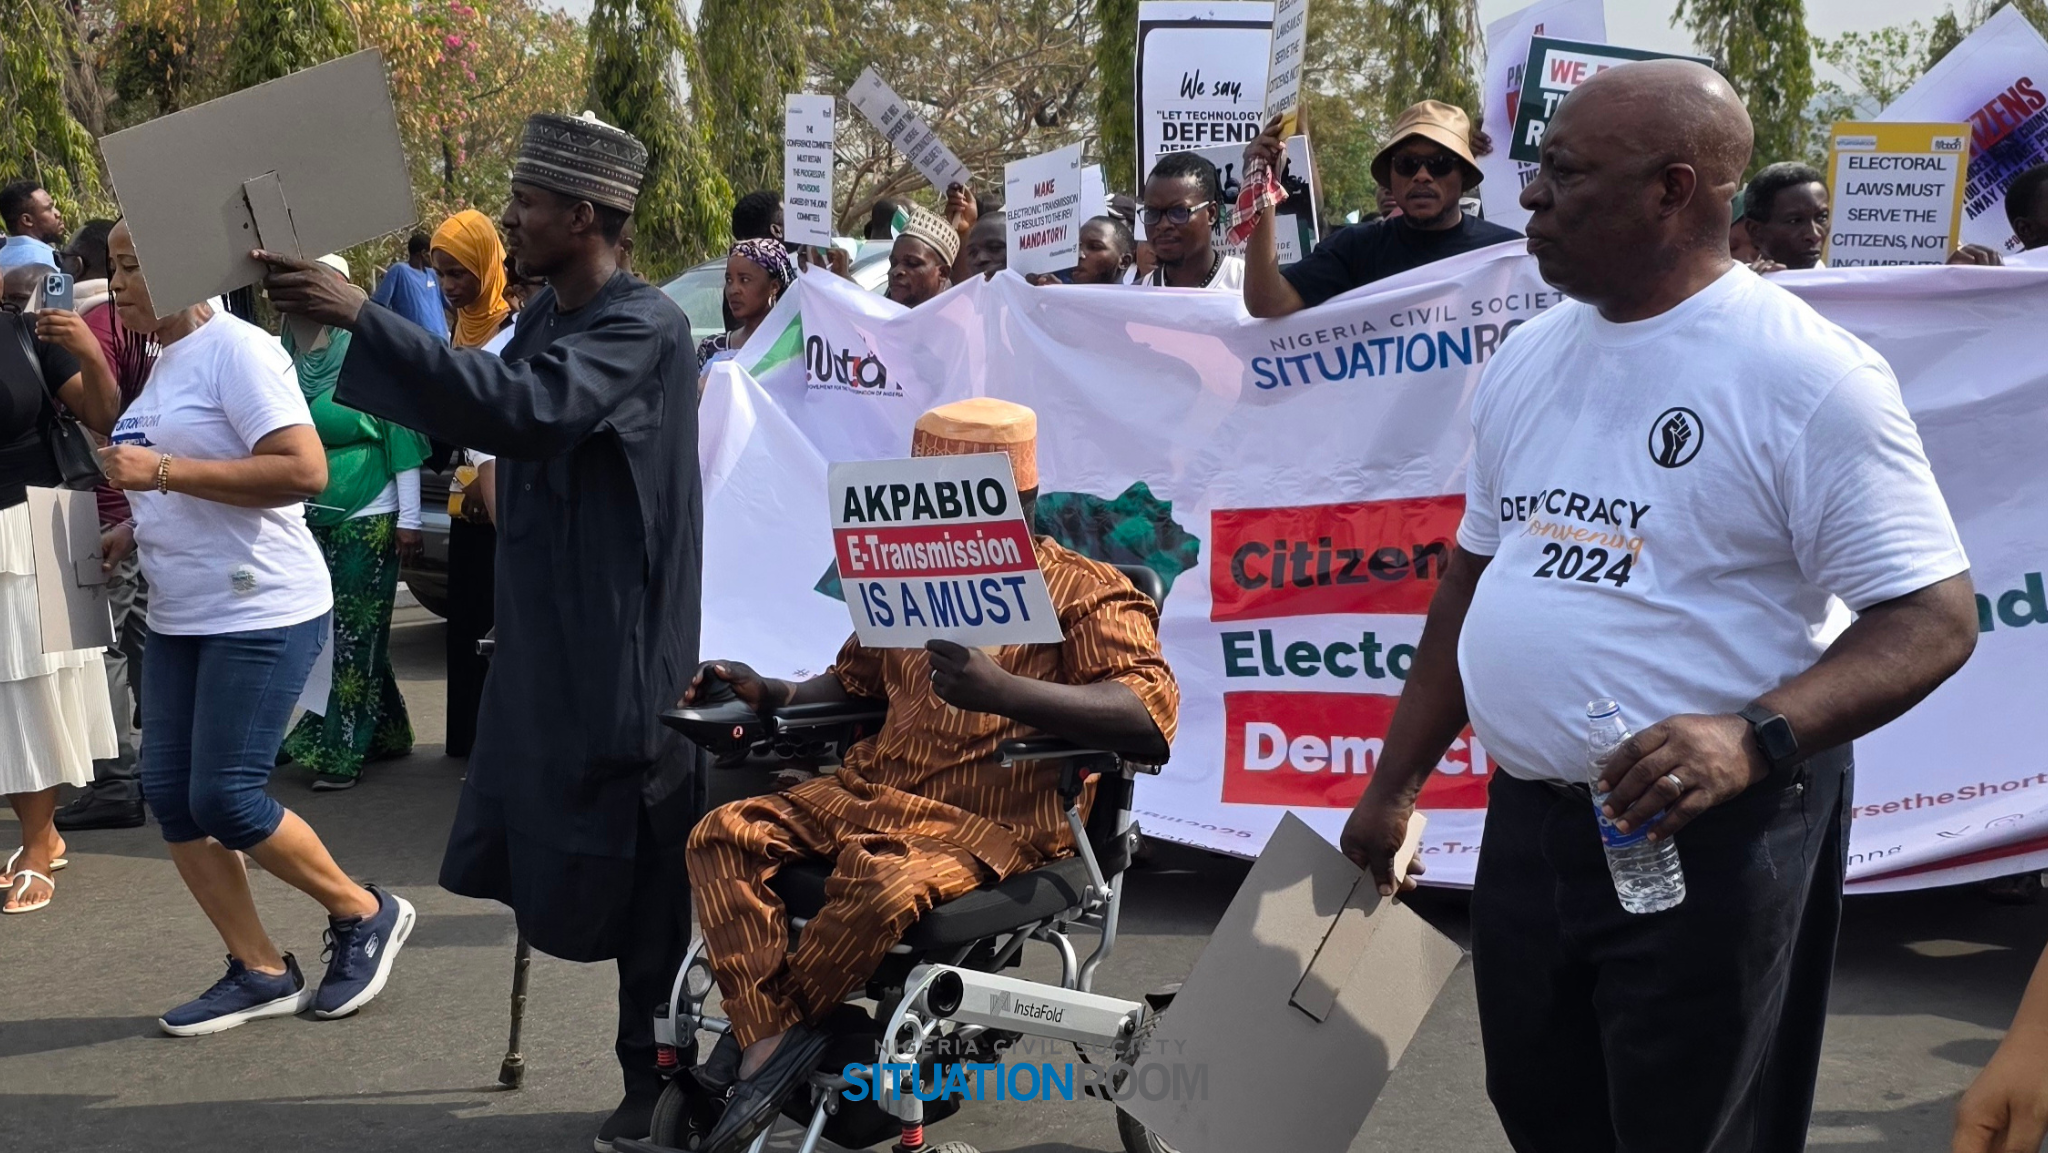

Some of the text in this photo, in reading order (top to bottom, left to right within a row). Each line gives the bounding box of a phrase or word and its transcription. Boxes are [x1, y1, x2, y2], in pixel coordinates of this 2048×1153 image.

[1180, 68, 1205, 100] We
[1550, 58, 1588, 85] WE
[1162, 121, 1260, 142] DEFEND
[1185, 111, 1263, 121] TECHNOLOGY
[1848, 156, 1947, 171] ELECTORAL
[1034, 178, 1055, 199] MAKE
[1846, 182, 1945, 197] LAWS MUST
[1964, 187, 1999, 221] AWAY
[1007, 193, 1078, 221] ELECTRONIC TRANSMISSION
[1014, 221, 1021, 232] OF
[1022, 216, 1044, 230] RESULTS
[1045, 214, 1052, 224] TO
[1052, 211, 1061, 222] THE
[1847, 208, 1937, 223] SERVE THE
[1831, 233, 1949, 250] CITIZENS, NOT
[1269, 292, 1563, 352] NIGERIA CIVIL SOCIET
[1251, 319, 1527, 390] SITUATIONR
[842, 477, 1008, 523] AKPABIO
[846, 530, 1022, 572] E-Transmission
[1519, 518, 1645, 566] onvening
[1230, 536, 1448, 590] Citizen
[1532, 542, 1633, 588] 2024
[858, 575, 1031, 628] IS A MUST
[1220, 628, 1420, 681] Electo
